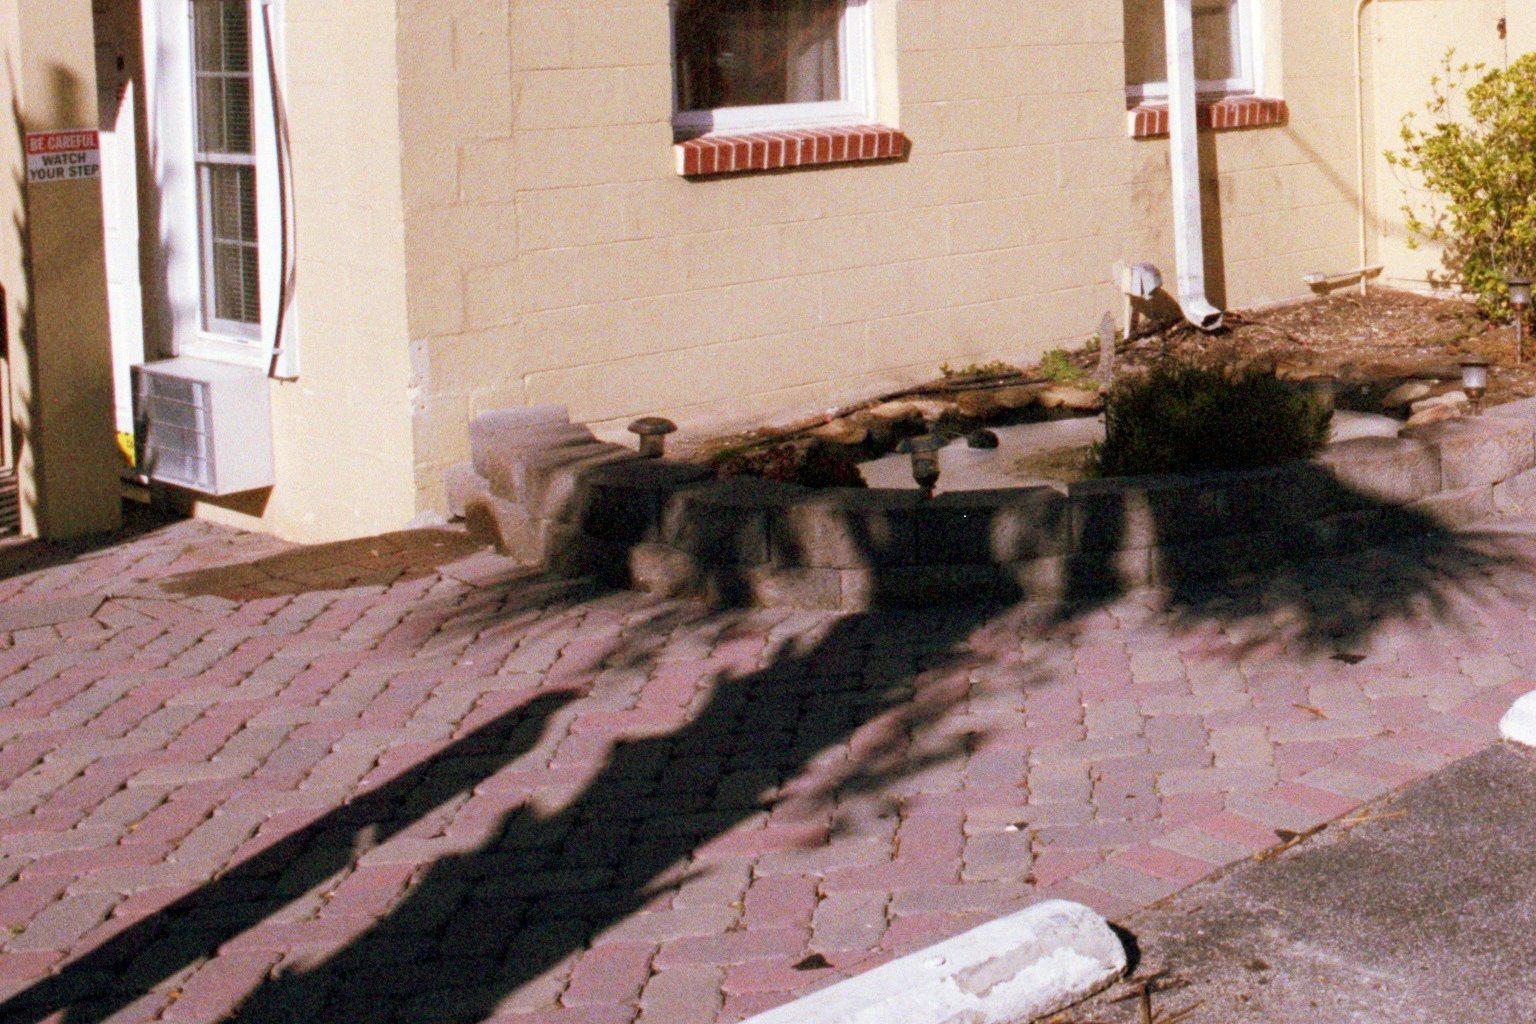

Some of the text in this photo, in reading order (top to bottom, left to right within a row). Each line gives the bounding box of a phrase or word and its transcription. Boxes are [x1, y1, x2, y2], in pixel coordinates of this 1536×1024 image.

[29, 134, 95, 151] BE CAREFUL
[43, 154, 86, 166] WATCH
[30, 165, 98, 179] YOUR STEP
